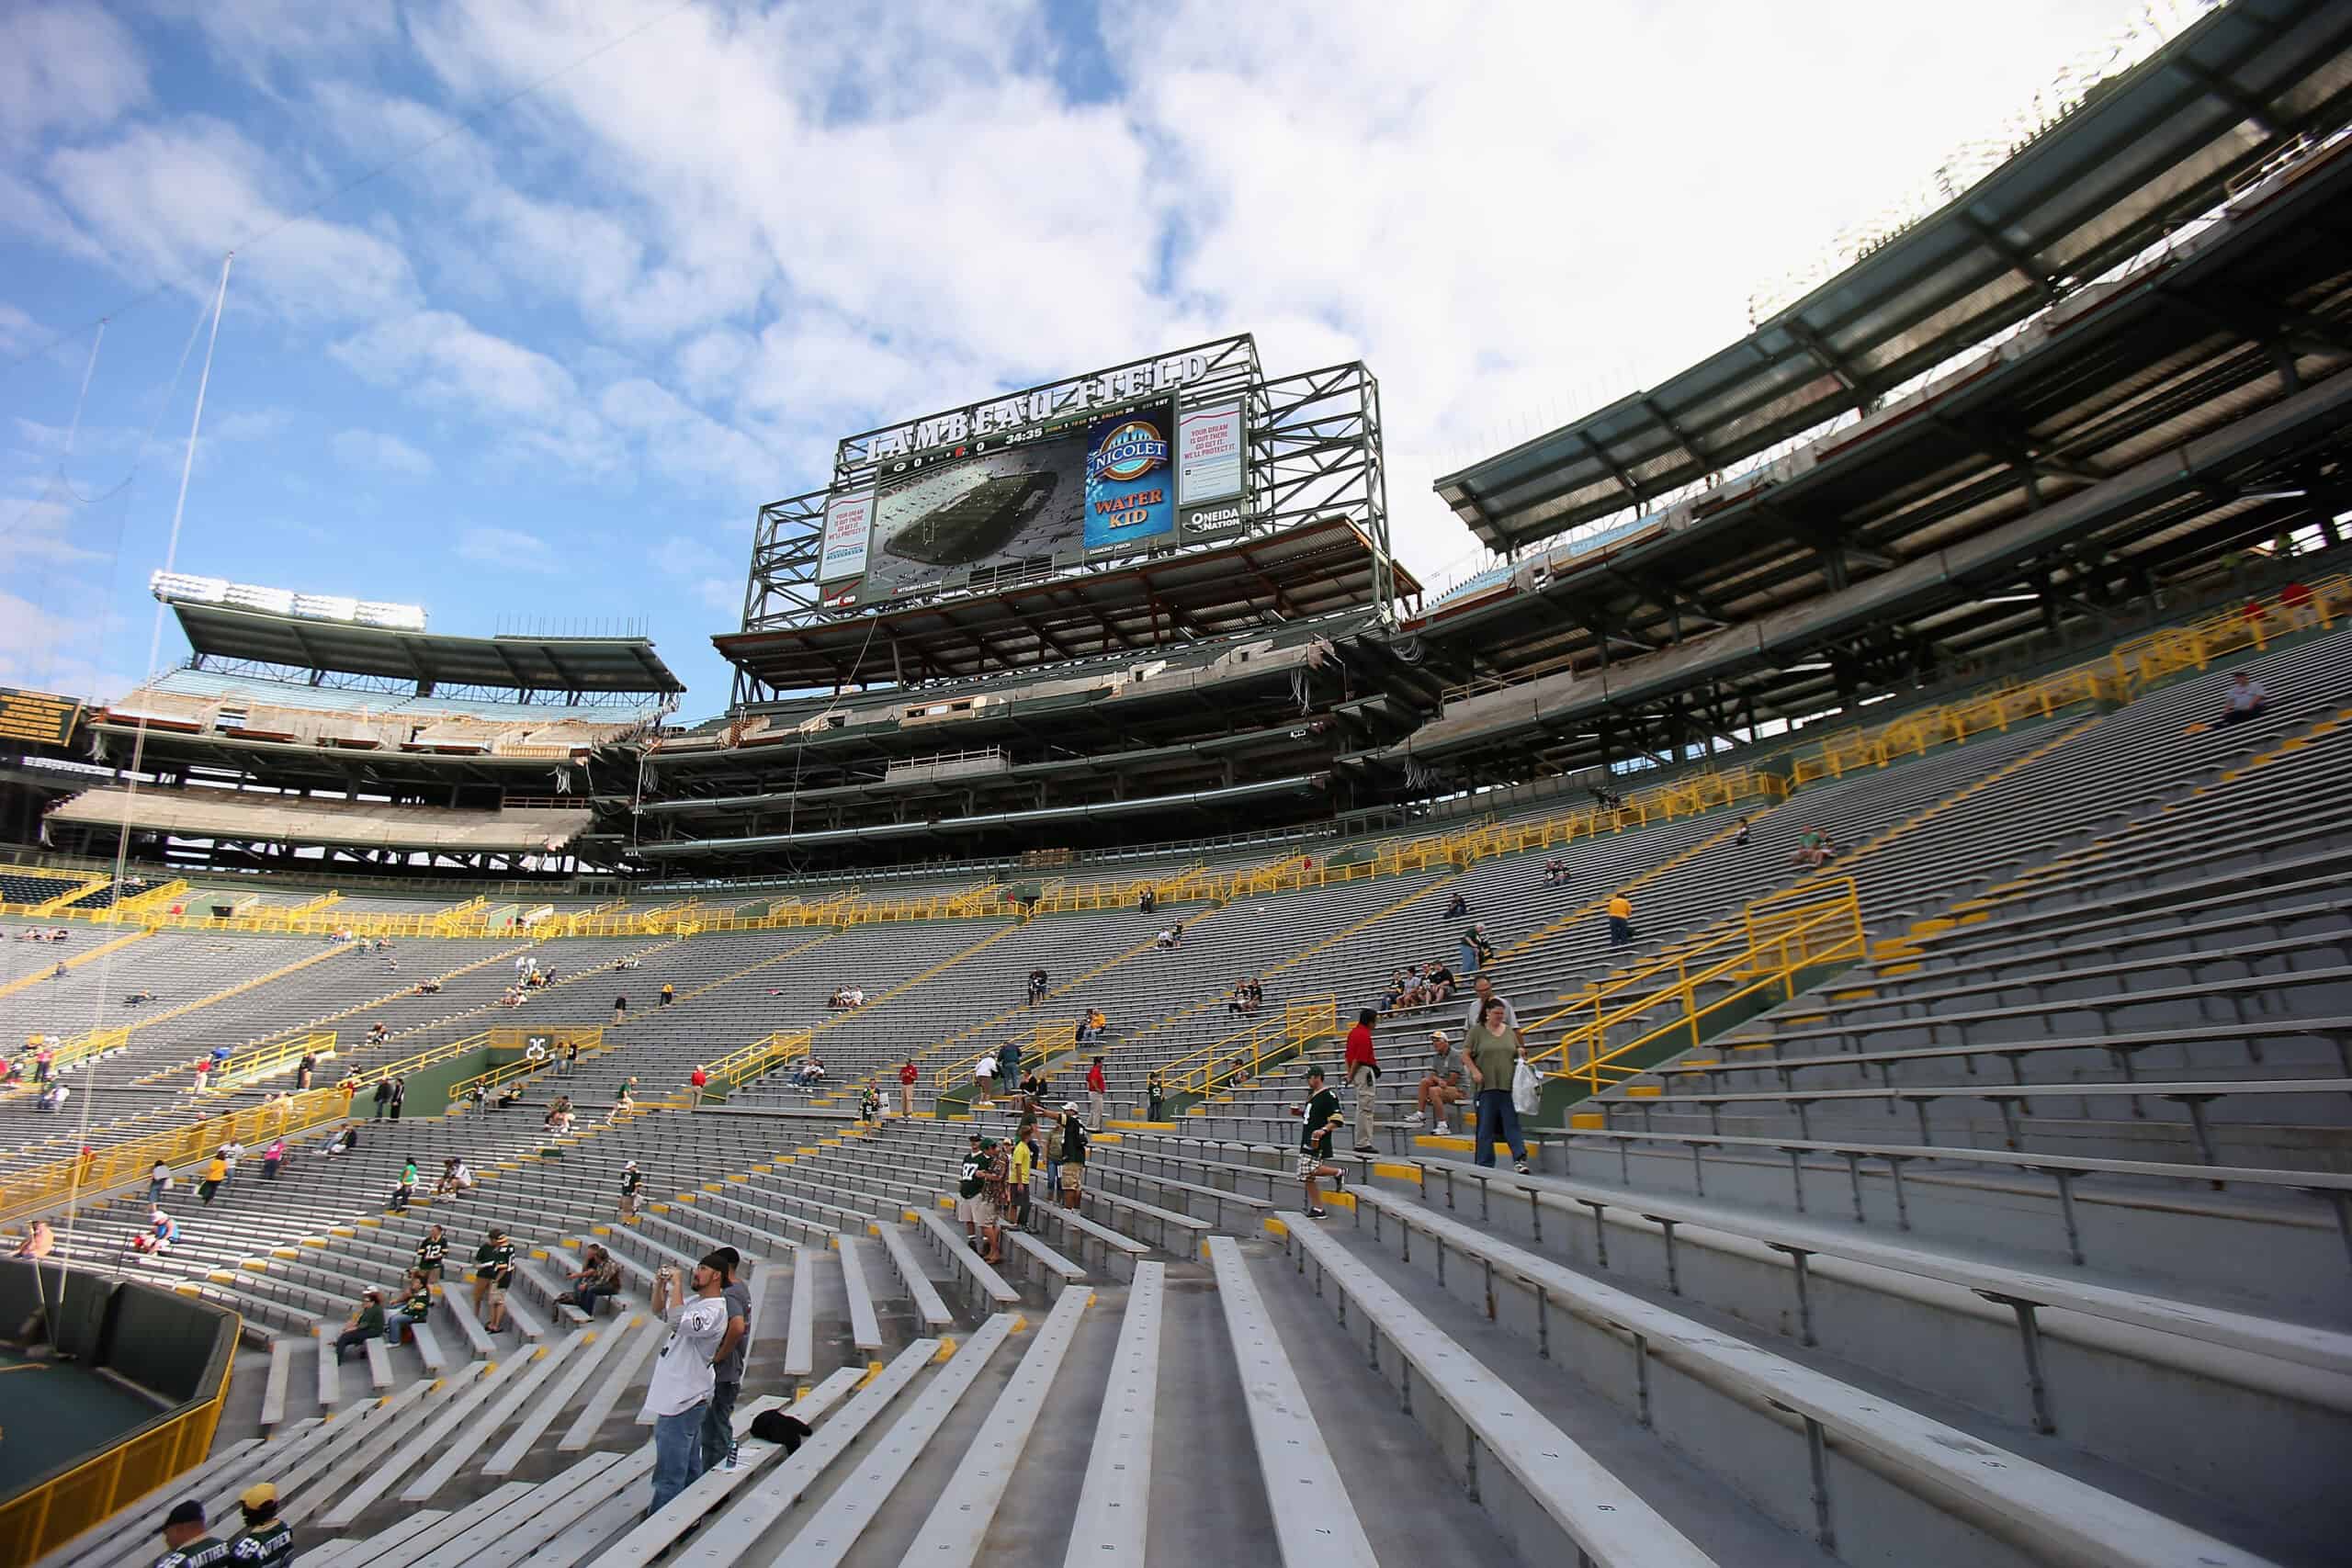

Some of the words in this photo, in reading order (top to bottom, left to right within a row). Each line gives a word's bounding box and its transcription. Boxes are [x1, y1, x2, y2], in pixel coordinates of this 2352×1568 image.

[865, 392, 1054, 463] LAMBEAU
[1073, 355, 1208, 411] FIELD
[1005, 425, 1043, 446] 34:35
[1191, 428, 1207, 437] YOUR
[1208, 423, 1228, 434] DREAM
[1197, 434, 1209, 443] OUT
[1210, 432, 1228, 441] THERE
[977, 442, 985, 451] 0
[1202, 445, 1228, 456] PROTECT
[913, 458, 922, 468] 0
[1095, 442, 1164, 470] NICOLET
[1095, 489, 1162, 514] WATER
[1109, 509, 1148, 529] KID
[1192, 508, 1239, 525] ONEIDA
[1203, 518, 1240, 530] NATION
[526, 1038, 546, 1060] 25
[962, 1163, 978, 1180] 87
[425, 1245, 442, 1260] 12
